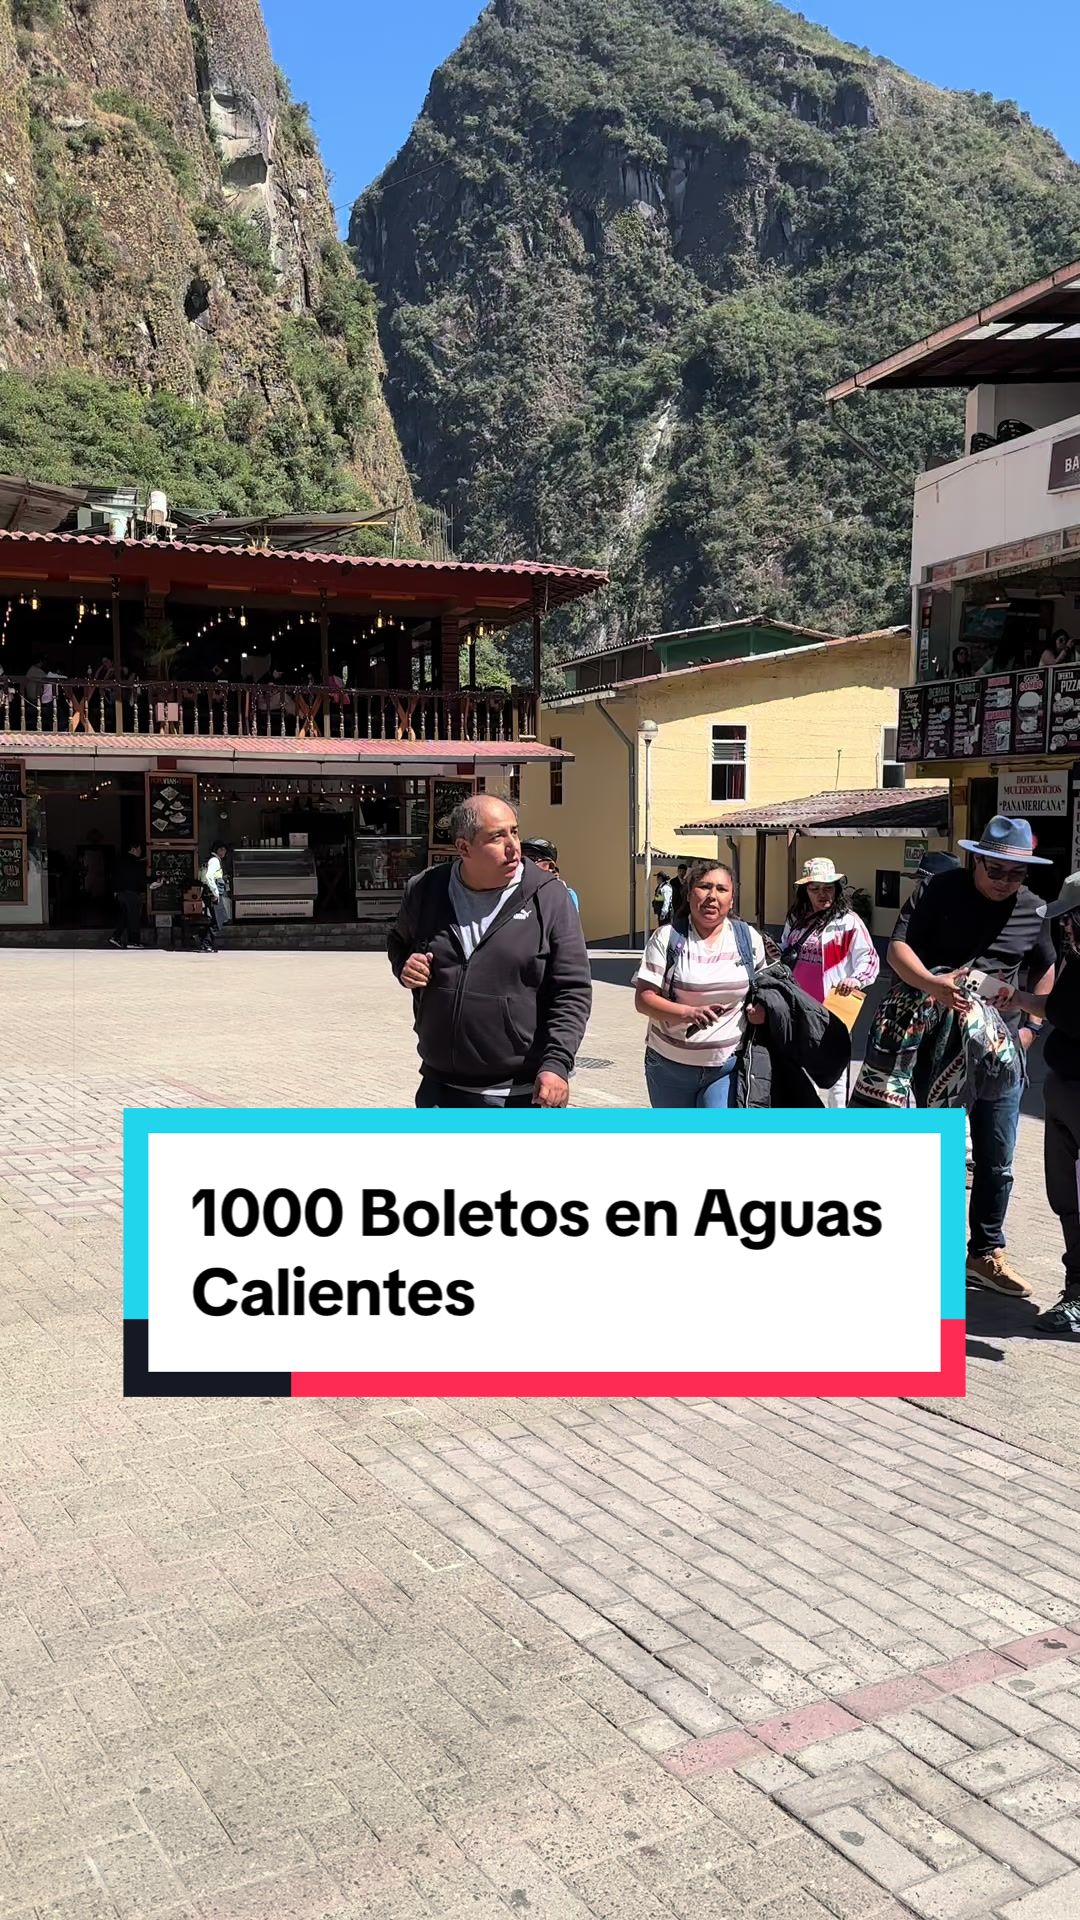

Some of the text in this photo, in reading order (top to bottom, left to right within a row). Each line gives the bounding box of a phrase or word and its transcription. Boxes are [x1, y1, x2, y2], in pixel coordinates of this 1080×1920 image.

[1016, 775, 1040, 784] BOTICA
[1003, 786, 1062, 795] MULTISERVICIOS
[1000, 800, 1065, 812] "PANAMERICANA"
